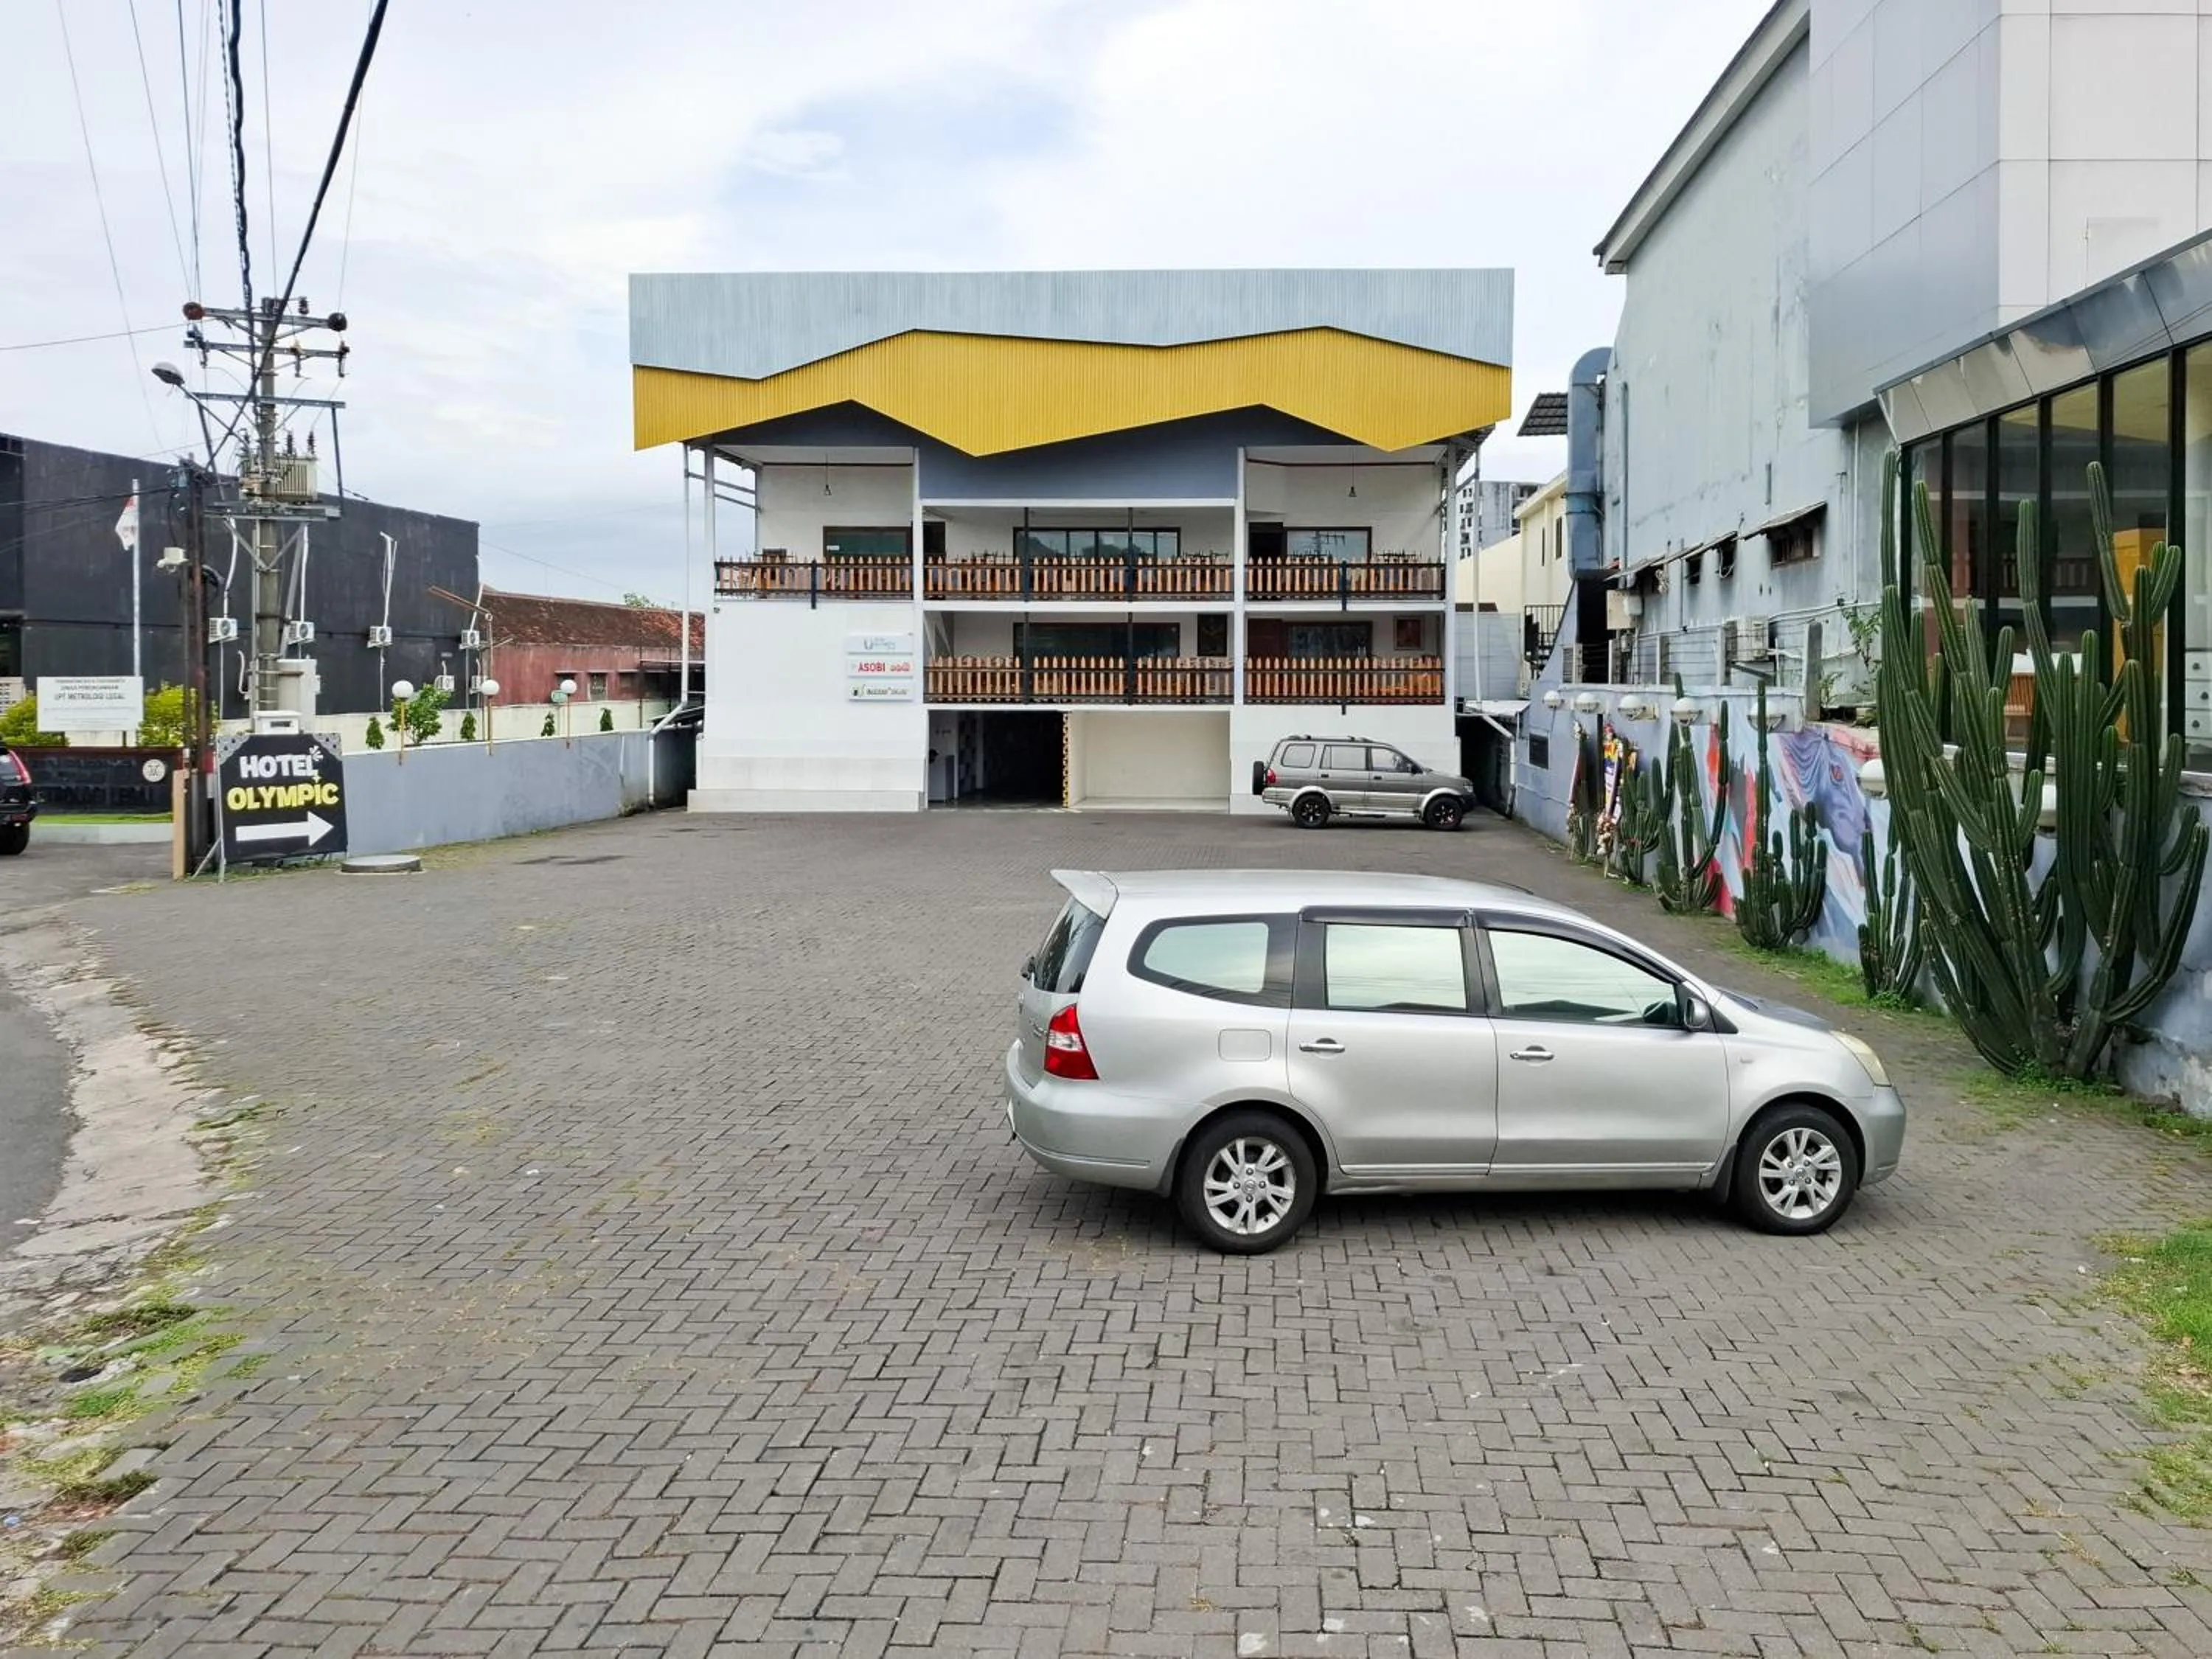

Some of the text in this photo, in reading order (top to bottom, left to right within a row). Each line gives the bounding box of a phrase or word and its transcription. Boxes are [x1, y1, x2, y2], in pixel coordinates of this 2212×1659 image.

[858, 662, 886, 672] ASOBI
[240, 754, 319, 779] HOTEL
[227, 783, 339, 810] OLYMPIC
